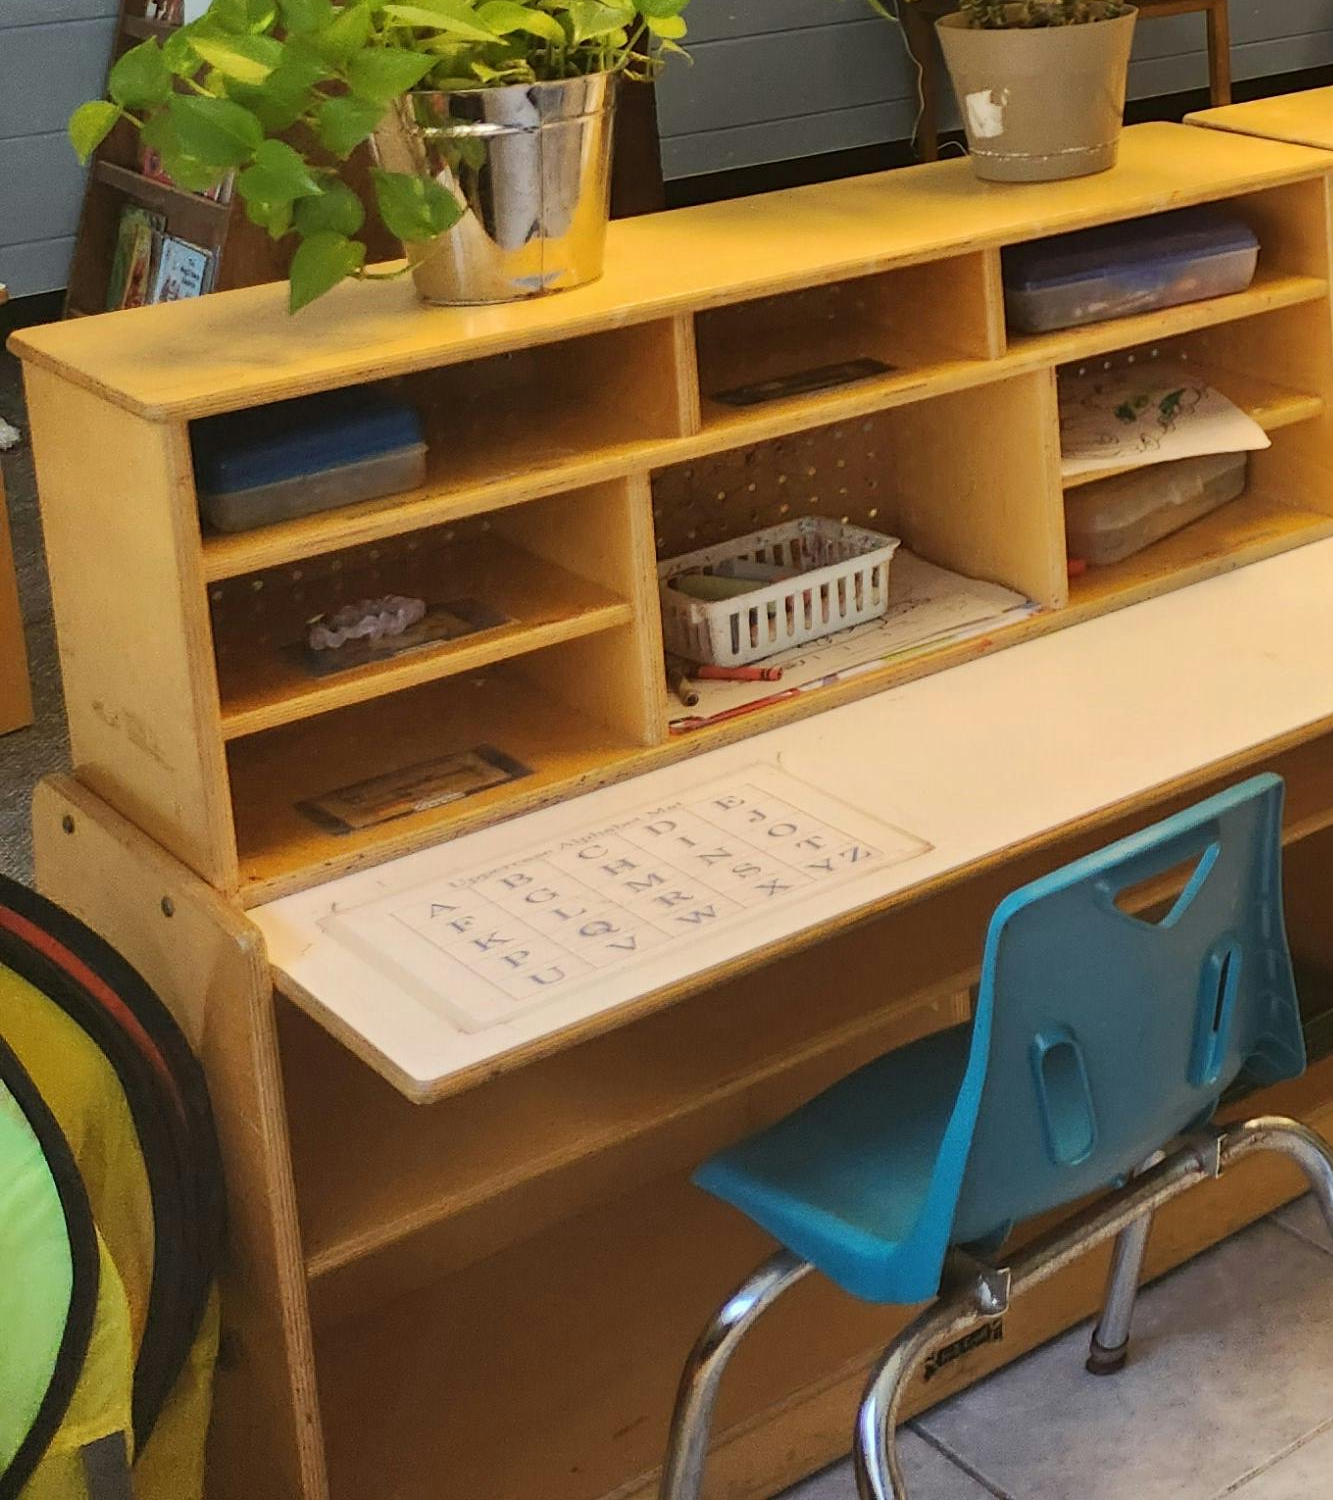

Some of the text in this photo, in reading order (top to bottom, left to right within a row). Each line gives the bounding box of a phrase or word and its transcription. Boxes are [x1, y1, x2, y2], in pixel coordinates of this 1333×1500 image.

[429, 795, 746, 918] A B C D E
[446, 809, 767, 934] F G H I J
[471, 822, 798, 952] K L M N O
[560, 817, 641, 850] Alphabet
[646, 802, 683, 816] Mat
[503, 835, 827, 969] P Q R S T
[528, 846, 873, 985] U V W X Y Z
